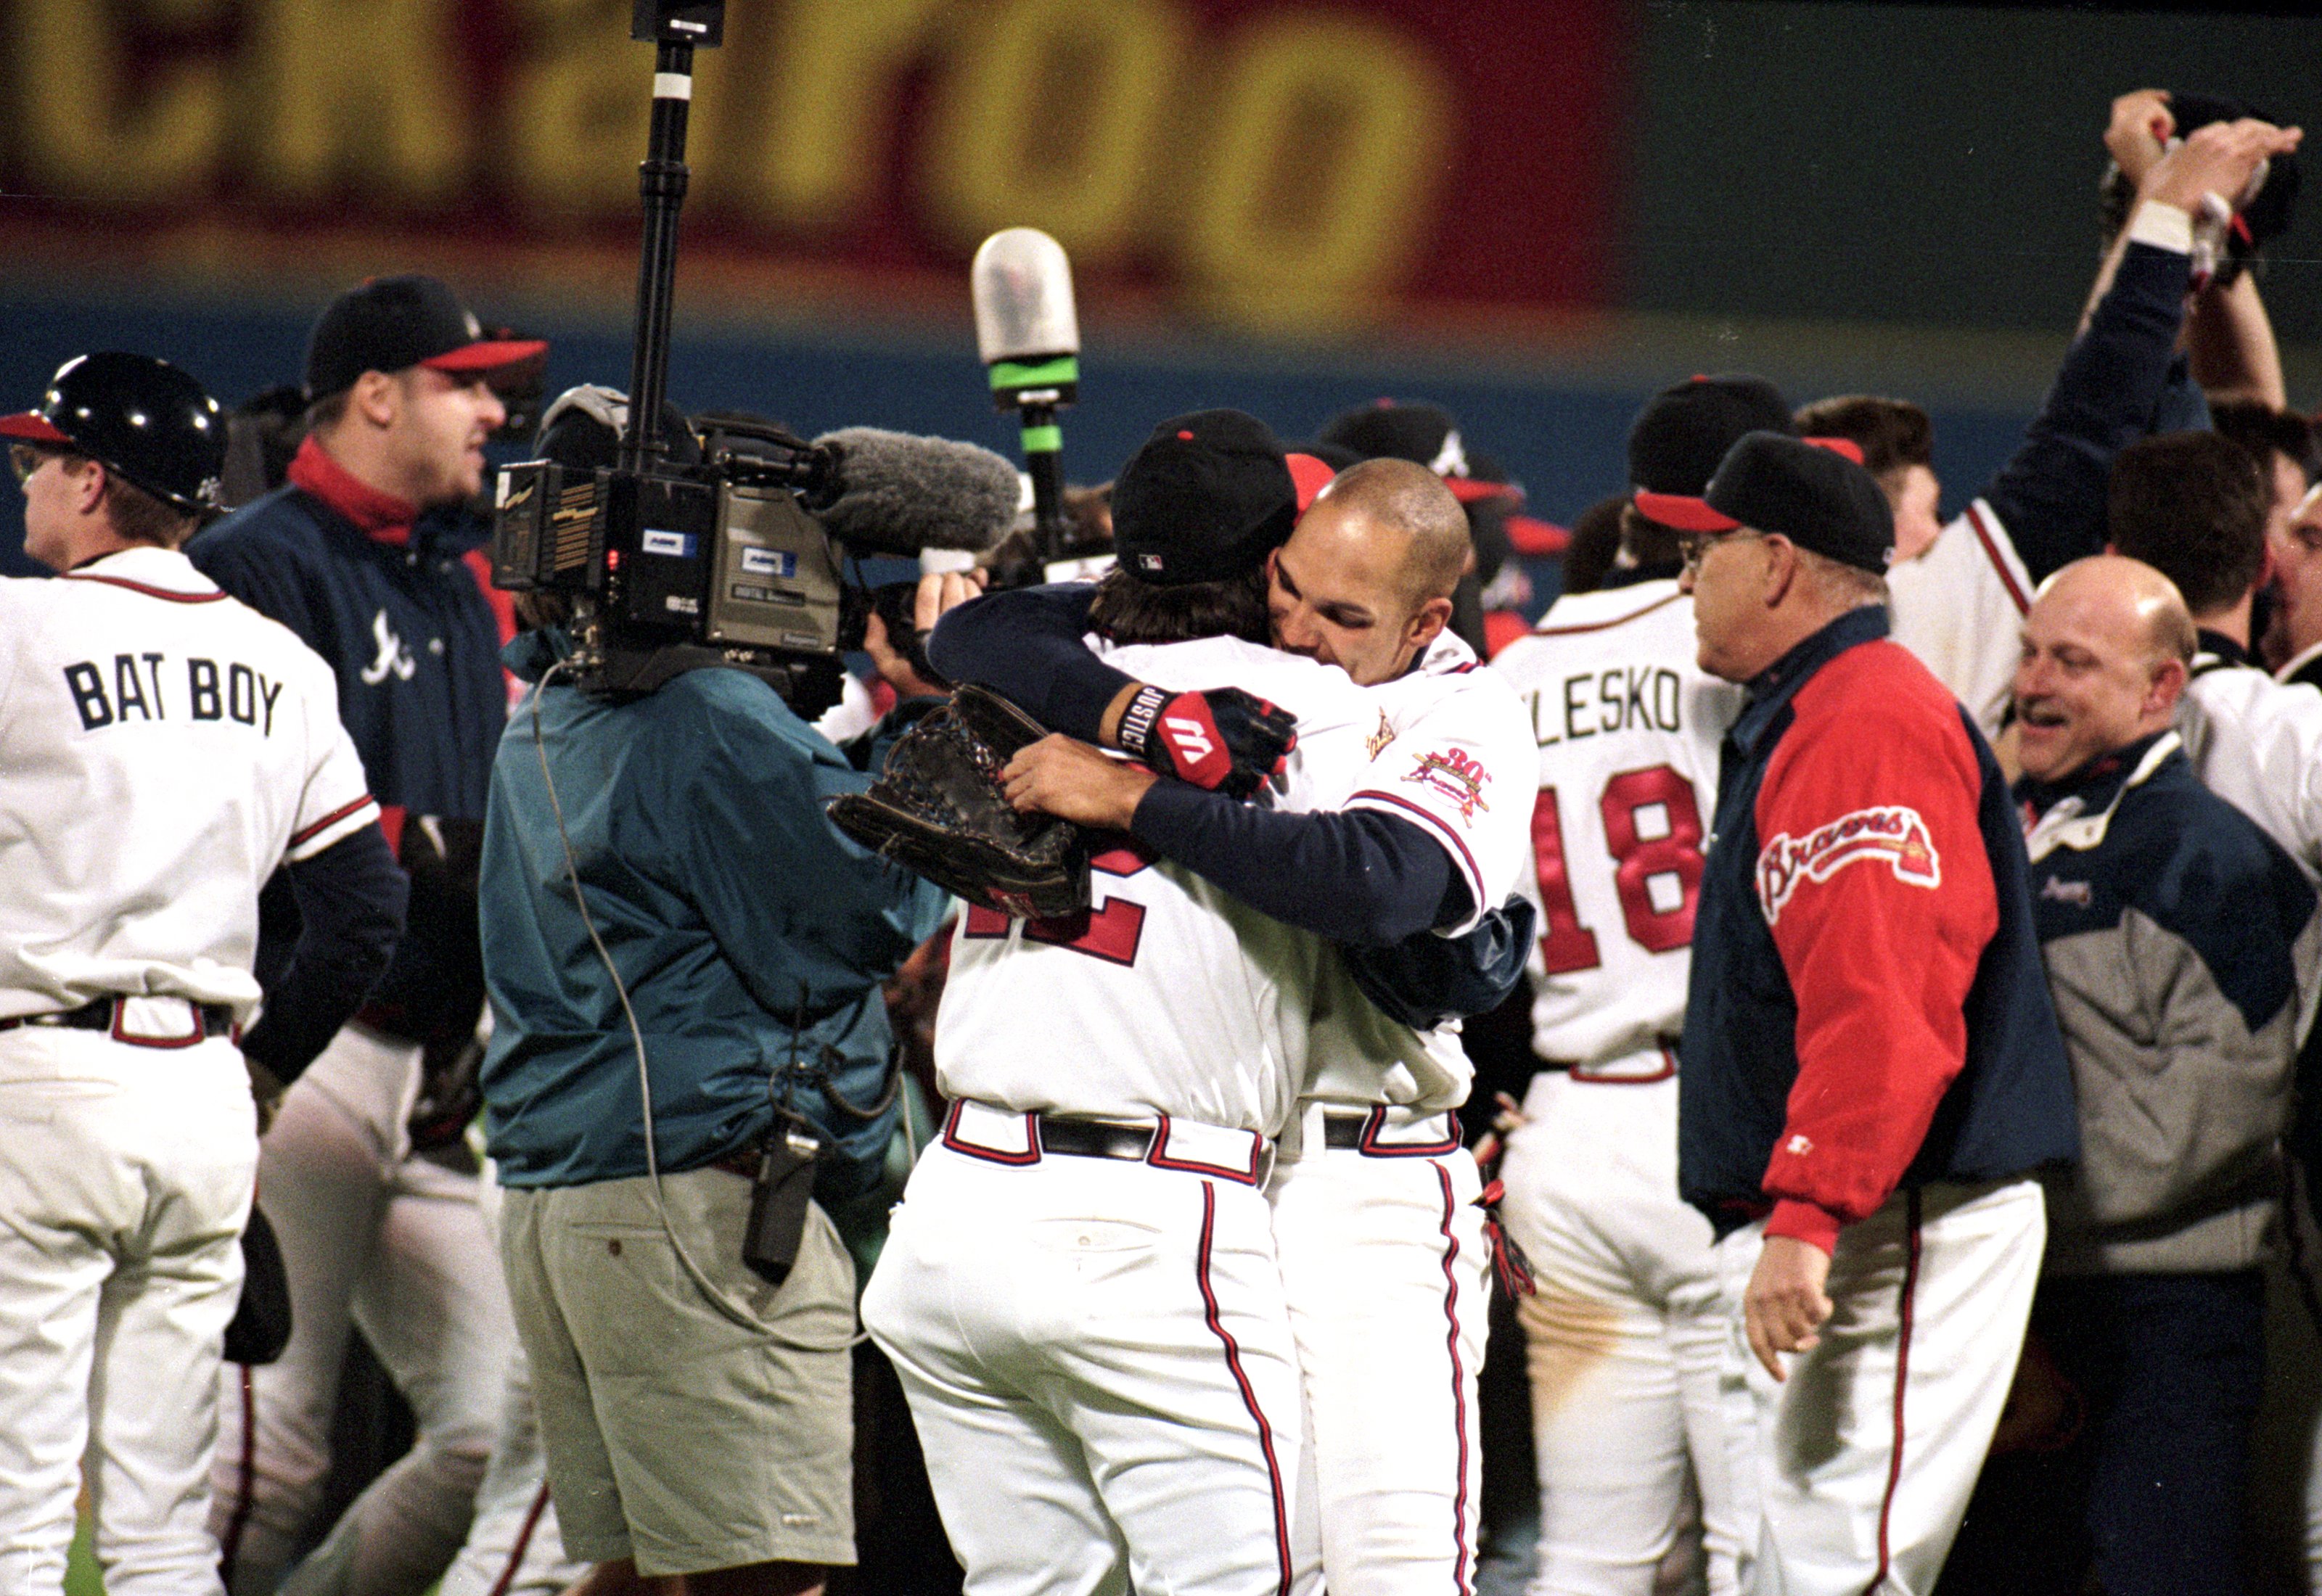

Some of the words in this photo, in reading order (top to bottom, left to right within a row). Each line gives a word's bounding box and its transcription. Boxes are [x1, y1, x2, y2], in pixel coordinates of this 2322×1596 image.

[63, 652, 165, 731] BAT
[186, 657, 284, 738] BOY
[1121, 686, 1165, 754] JUSTICE
[1521, 665, 1681, 749] LESKO
[1530, 763, 1705, 976] 18
[1757, 806, 1916, 926] Braves
